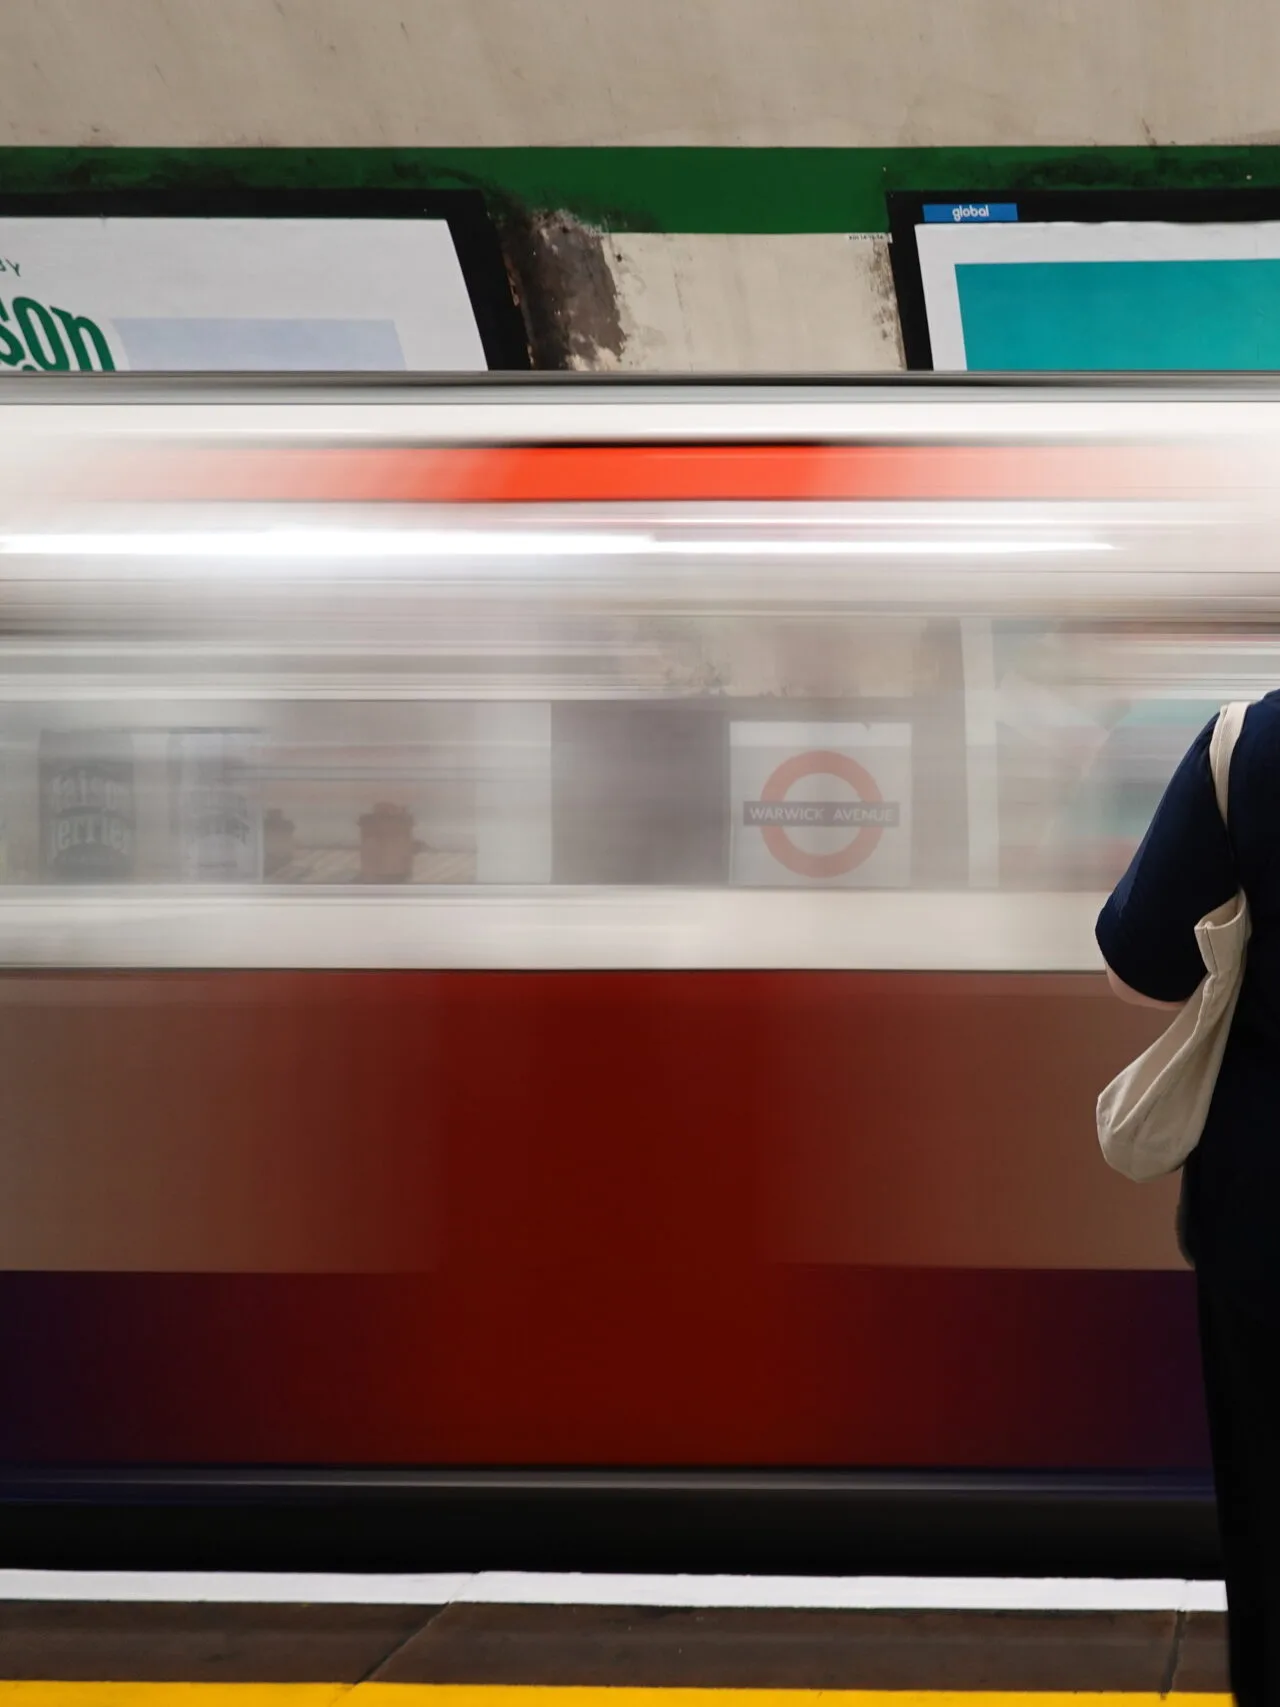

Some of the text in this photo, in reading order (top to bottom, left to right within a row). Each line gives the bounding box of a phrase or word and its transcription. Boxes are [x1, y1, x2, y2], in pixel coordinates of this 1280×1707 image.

[952, 204, 990, 222] global
[749, 806, 895, 822] WARWICK AVENUE
